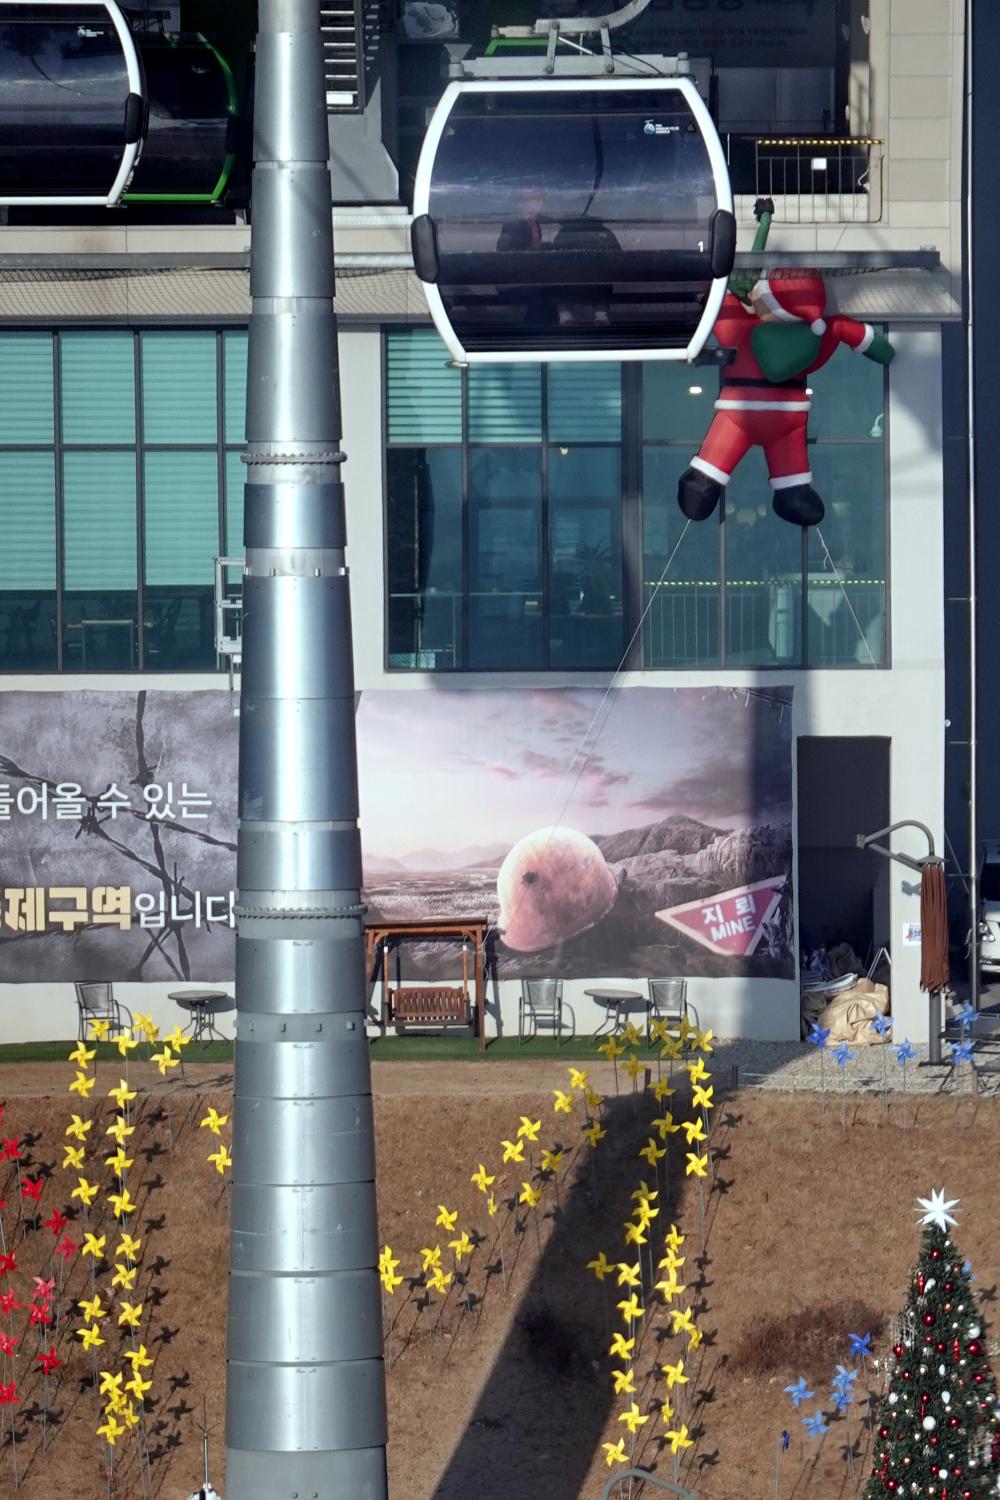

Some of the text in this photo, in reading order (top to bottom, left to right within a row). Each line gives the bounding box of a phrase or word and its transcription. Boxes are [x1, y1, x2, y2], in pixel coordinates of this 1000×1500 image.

[97, 783, 131, 819] 수
[143, 782, 212, 819] 있는
[0, 886, 235, 931] 제구역입니다
[710, 915, 756, 942] MINE
